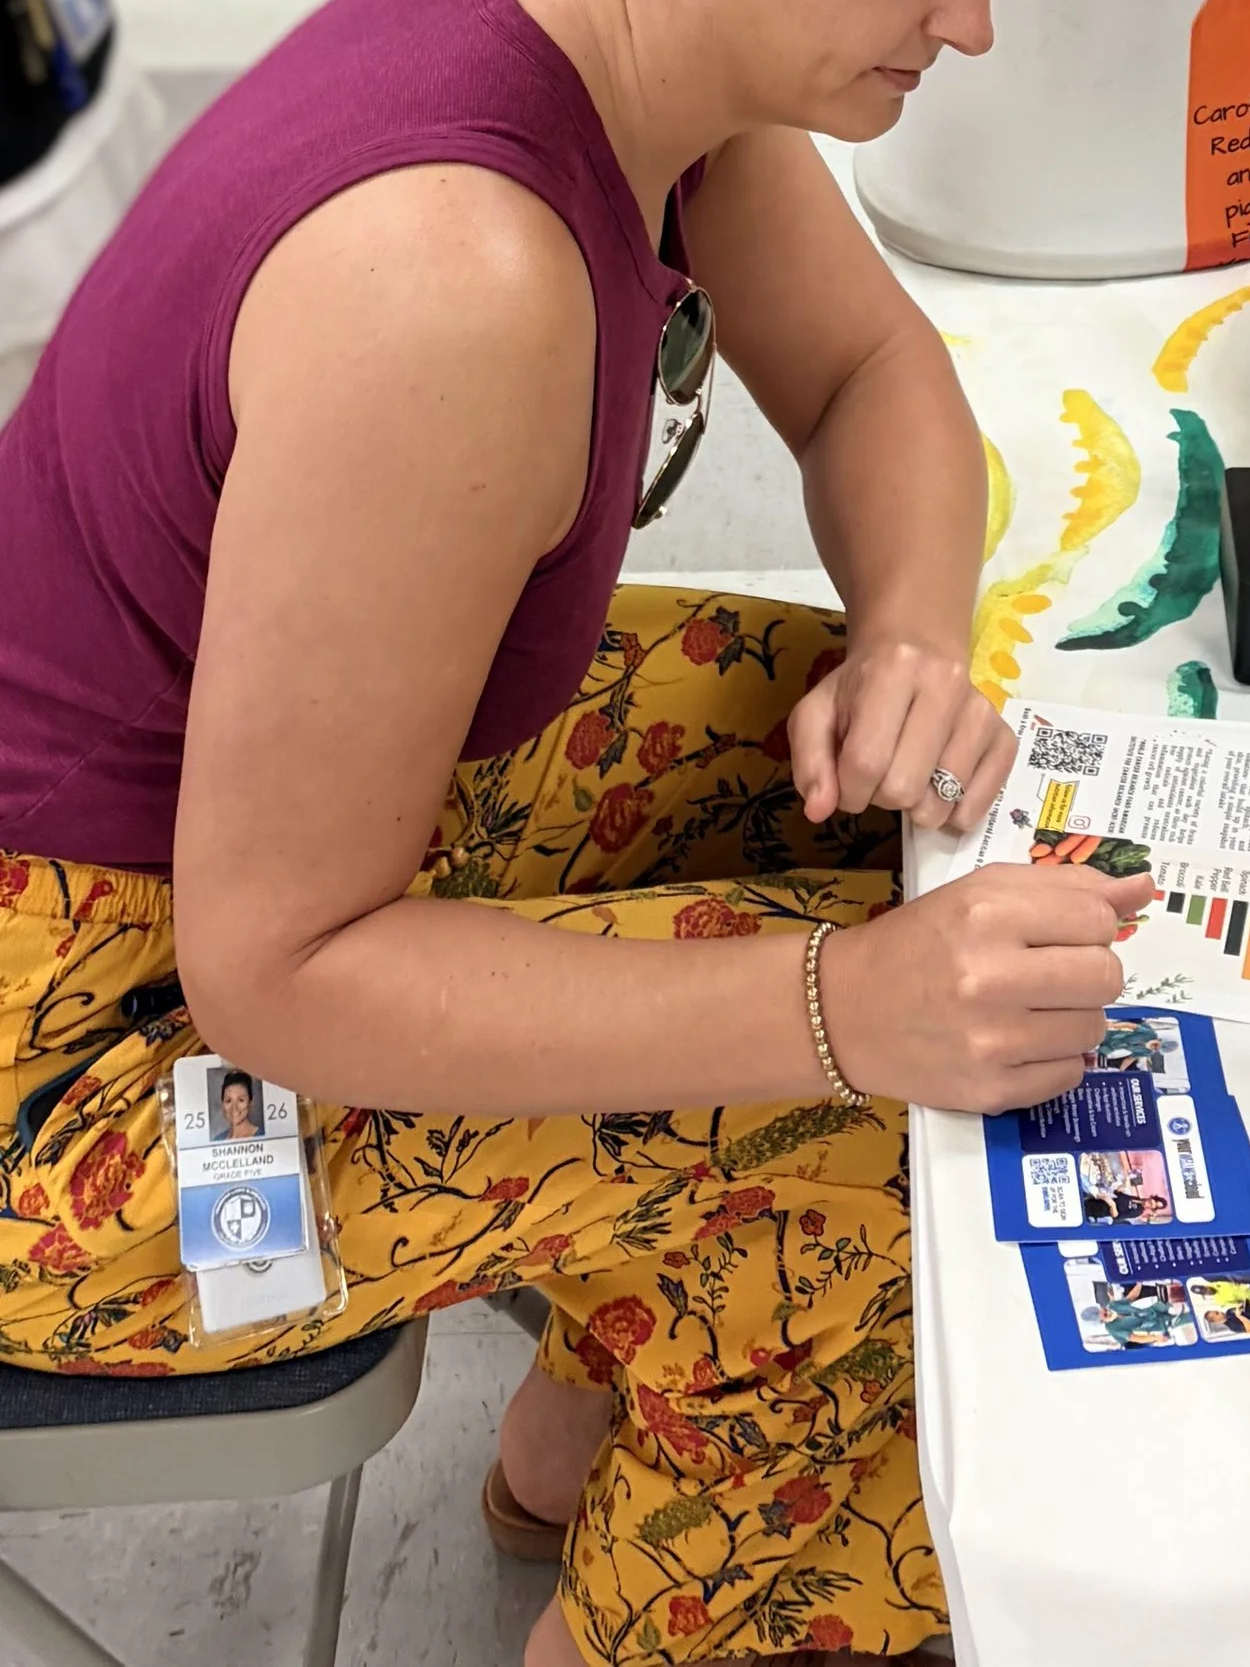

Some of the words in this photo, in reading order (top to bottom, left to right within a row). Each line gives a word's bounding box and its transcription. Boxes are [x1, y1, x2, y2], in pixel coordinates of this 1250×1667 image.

[1130, 1078, 1141, 1094] OUR
[184, 1112, 206, 1130] 25
[266, 1103, 288, 1121] 26
[1133, 1093, 1146, 1124] SERVICES
[211, 1143, 264, 1158] SHANNON
[202, 1154, 274, 1172] MCCLELLAND
